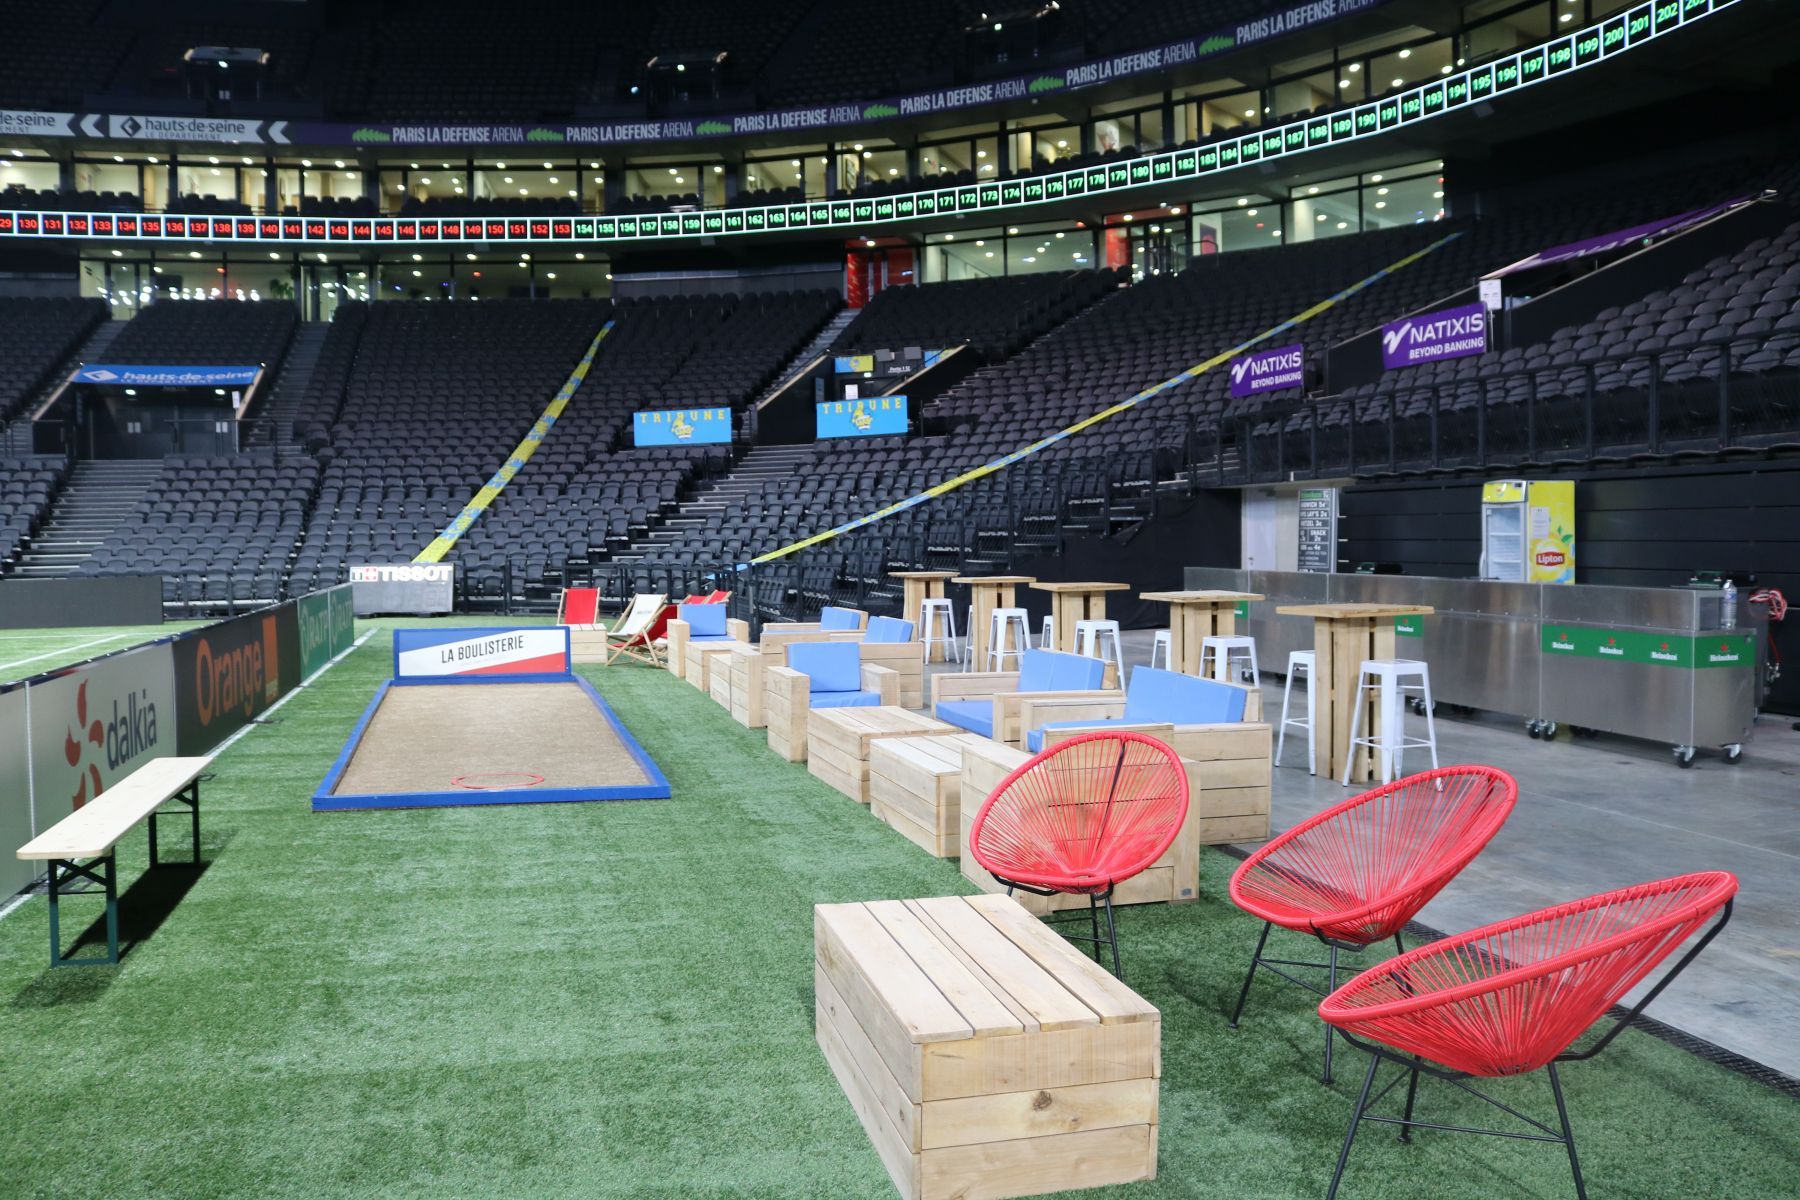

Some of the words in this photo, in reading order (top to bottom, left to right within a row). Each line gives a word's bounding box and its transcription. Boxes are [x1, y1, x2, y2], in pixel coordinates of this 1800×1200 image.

[1236, 18, 1269, 45] PARIS
[1270, 16, 1284, 35] LA
[1287, 0, 1337, 30] DEFENSE
[1338, 0, 1373, 14] ARE
[1066, 64, 1097, 86] PARIS
[1098, 61, 1113, 80] LA
[1114, 51, 1162, 75] DEFENSE
[1163, 41, 1196, 64] ARENA
[900, 95, 931, 115] PARIS
[932, 92, 945, 110] LA
[947, 84, 993, 107] DEFENSE
[995, 80, 1026, 100] ARENA
[0, 218, 12, 228] 29
[19, 219, 38, 229] 130
[44, 219, 62, 229] 131
[69, 220, 87, 231] 132
[94, 220, 112, 231] 133
[118, 221, 136, 232] 134
[142, 221, 160, 232] 135
[167, 222, 184, 232] 136
[190, 222, 208, 233] 137
[214, 223, 232, 233] 138
[238, 223, 255, 234] 139
[261, 224, 279, 234] 140
[285, 224, 301, 234] 141
[308, 225, 325, 235] 142
[331, 225, 348, 236] 143
[354, 225, 371, 235] 144
[376, 225, 393, 236] 145
[398, 225, 415, 235] 146
[421, 225, 437, 235] 147
[443, 225, 460, 235] 148
[465, 225, 482, 235] 149
[488, 224, 504, 235] 150
[510, 224, 525, 235] 151
[532, 224, 548, 235] 152
[554, 224, 571, 234] 153
[575, 223, 593, 234] 154
[597, 223, 615, 234] 155
[619, 222, 636, 233] 156
[641, 221, 658, 232] 157
[662, 220, 679, 231] 158
[684, 218, 701, 230] 159
[705, 217, 722, 228] 160
[727, 216, 742, 227] 161
[748, 214, 764, 225] 162
[769, 212, 785, 224] 163
[790, 211, 806, 222] 164
[812, 209, 828, 220] 165
[834, 208, 850, 219] 166
[856, 205, 872, 217] 167
[877, 204, 893, 215] 168
[897, 201, 913, 212] 169
[918, 198, 934, 209] 170
[939, 196, 954, 207] 171
[960, 193, 977, 204] 172
[981, 190, 999, 202] 173
[1004, 187, 1021, 199] 174
[1026, 184, 1042, 197] 175
[1047, 181, 1065, 193] 176
[1067, 177, 1086, 190] 177
[1088, 173, 1107, 186] 178
[1110, 170, 1129, 182] 179
[1132, 165, 1150, 178] 180
[1154, 161, 1171, 175] 181
[1177, 157, 1195, 170] 182
[1199, 153, 1217, 165] 183
[1221, 149, 1238, 161] 184
[1243, 142, 1260, 156] 185
[1264, 137, 1282, 150] 186
[1286, 131, 1304, 145] 187
[1309, 126, 1328, 140] 188
[1333, 120, 1352, 134] 189
[1357, 113, 1376, 127] 190
[1380, 107, 1398, 121] 191
[1402, 99, 1420, 114] 192
[1424, 91, 1443, 106] 193
[1448, 84, 1467, 99] 194
[1472, 74, 1492, 91] 195
[1497, 66, 1517, 82] 196
[1522, 57, 1544, 74] 197
[1549, 48, 1572, 65] 198
[1577, 37, 1599, 56] 199
[1604, 27, 1624, 46] 200
[1629, 15, 1650, 35] 201
[1656, 2, 1678, 23] 202
[566, 126, 599, 142] PARIS
[600, 125, 614, 141] LA
[615, 122, 661, 140] DEFENSE
[663, 121, 693, 138] ARENA
[734, 116, 765, 132] PARIS
[766, 114, 780, 130] LA
[781, 110, 828, 127] DEFENSE
[829, 106, 860, 123] ARENA
[392, 127, 425, 142] PARIS
[426, 127, 441, 142] LA
[442, 127, 490, 142] DEFENSE
[492, 127, 524, 142] ARENA
[1410, 313, 1484, 344] NATIXIS
[1409, 345, 1443, 360] BEYOND
[1445, 336, 1484, 353] BANKING
[1251, 351, 1302, 376] NATIXIS
[1251, 378, 1274, 389] BEYOND
[1275, 371, 1302, 385] BANKING
[1538, 555, 1563, 564] Lipton
[378, 565, 452, 582] TISSOT
[441, 648, 454, 663] LA
[458, 635, 524, 660] BOULISTERIE
[196, 639, 262, 726] Orange
[107, 688, 157, 771] dalkia
